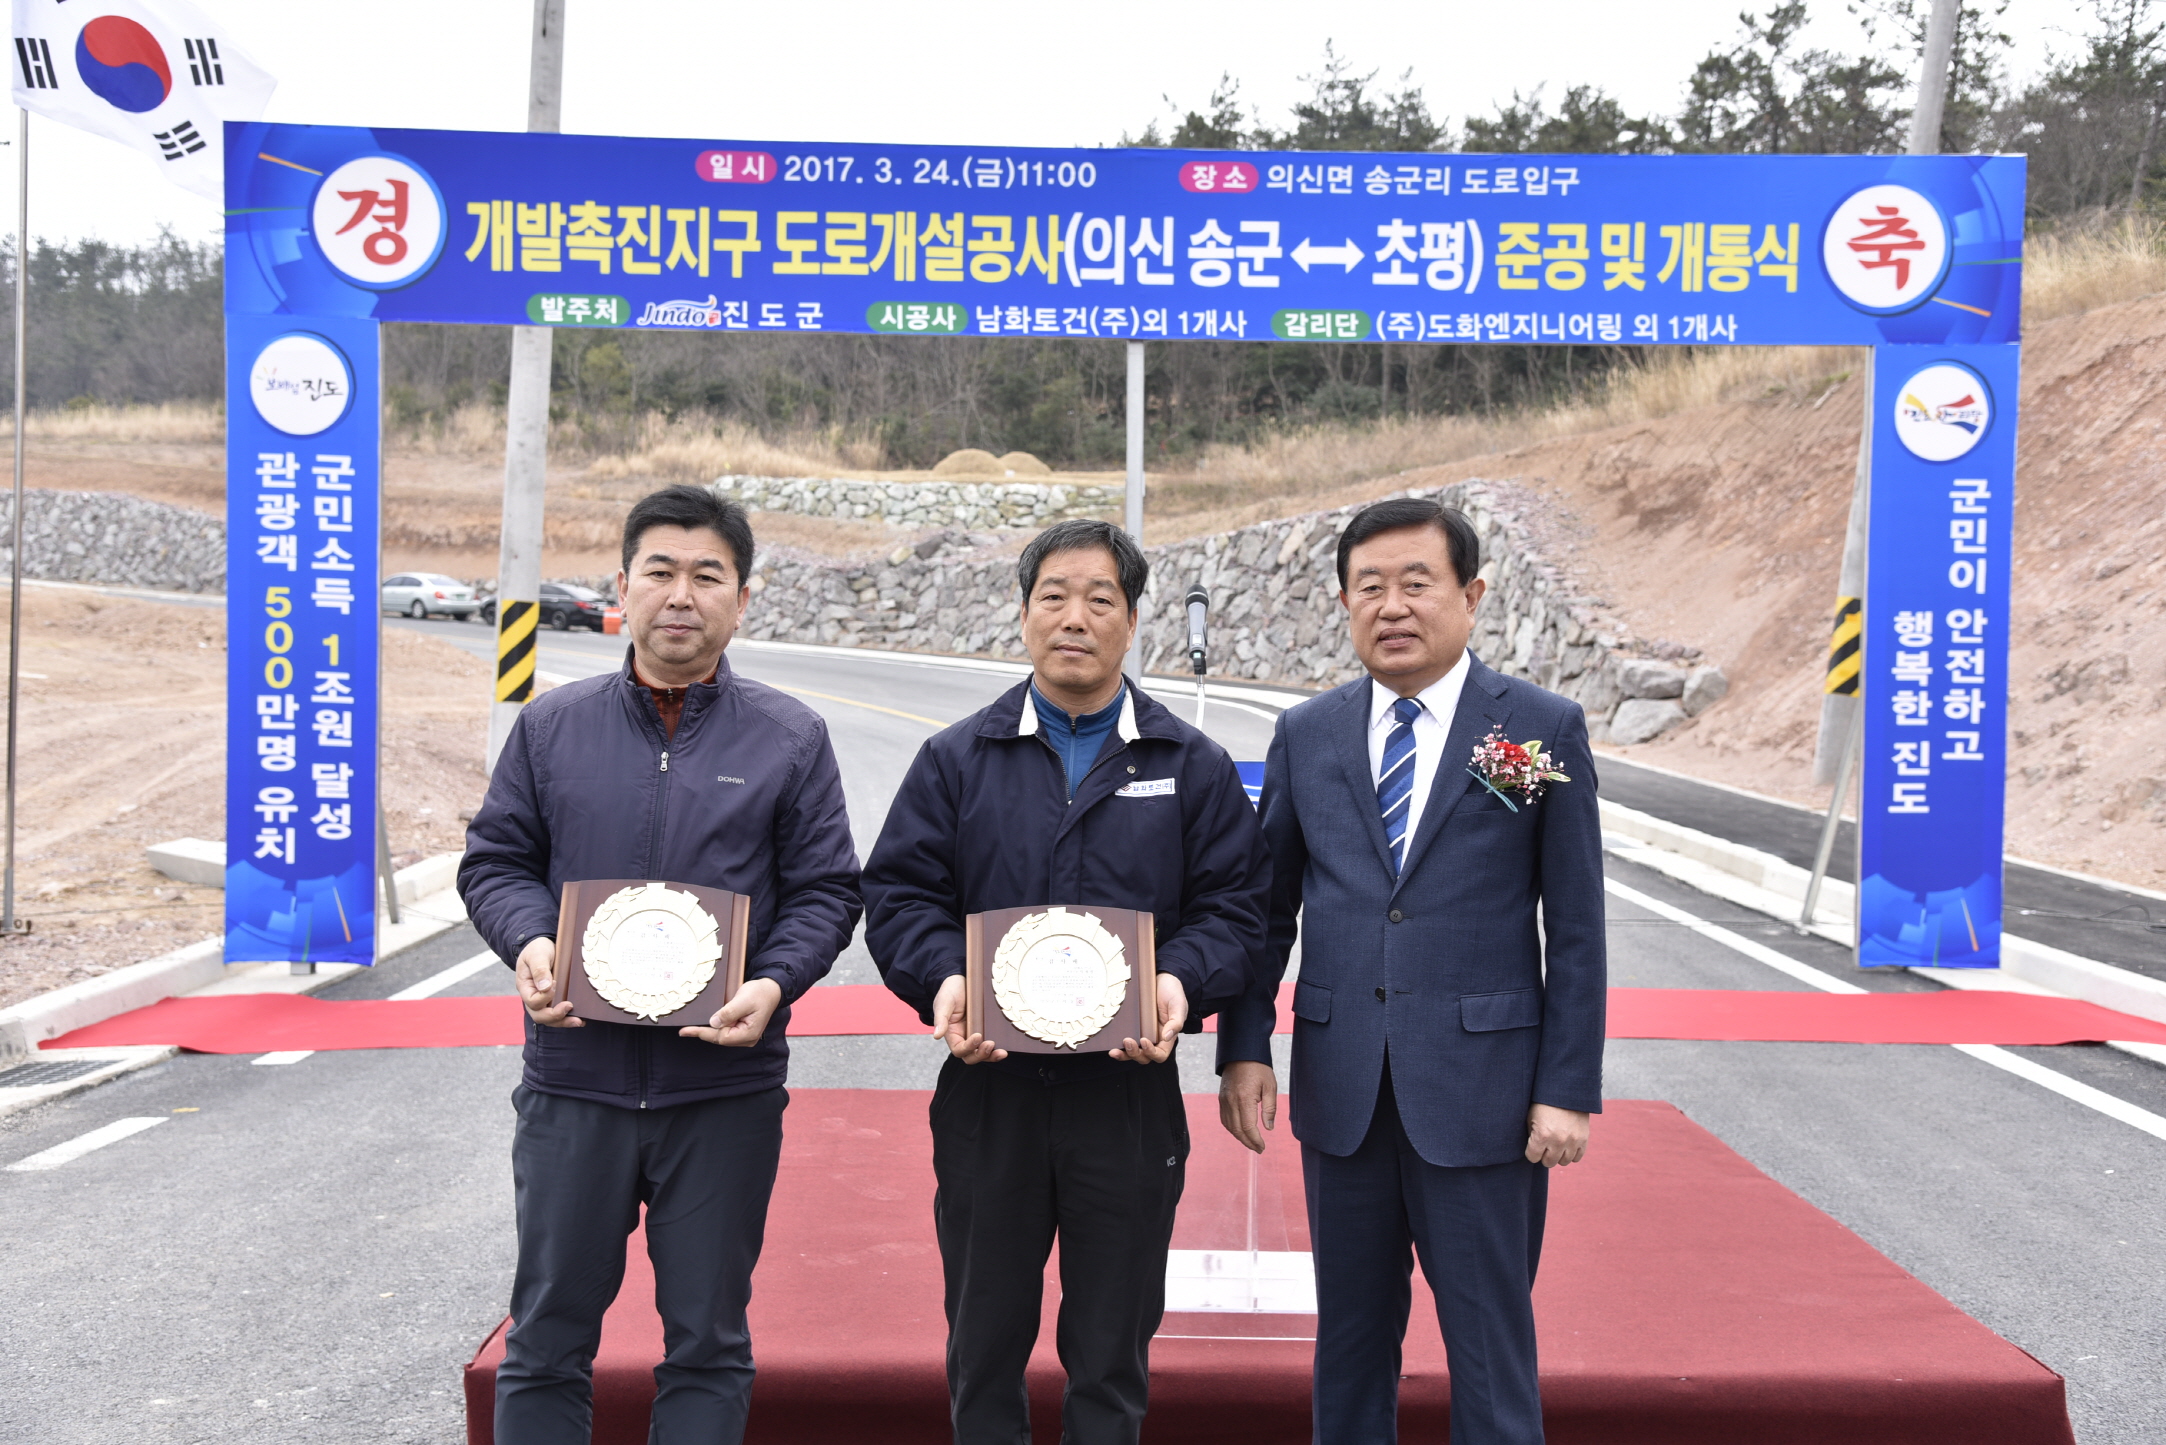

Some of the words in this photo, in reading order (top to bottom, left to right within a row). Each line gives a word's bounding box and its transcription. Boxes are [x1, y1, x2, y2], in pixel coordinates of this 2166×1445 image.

[784, 155, 863, 184] 2017.
[1266, 164, 1353, 194] 의신면
[1363, 165, 1451, 196] 송군리
[1461, 166, 1580, 196] 도로입구
[334, 178, 410, 266] 경
[465, 200, 762, 279] 개발촉진지구
[1495, 222, 1590, 291] 준공
[1600, 221, 1646, 292] 및
[1657, 222, 1800, 293] 개통식
[1847, 205, 1926, 290] 축
[541, 296, 619, 324] 발주처
[880, 304, 957, 331] 시공사
[1178, 309, 1248, 338] 1개사
[1284, 312, 1360, 338] 감리단
[1376, 310, 1622, 342] (주)도화엔지니어링
[1633, 313, 1659, 342] 외
[1668, 313, 1738, 342] 1개사
[302, 378, 345, 402] 진도
[255, 452, 301, 572] 관광객
[311, 454, 356, 615] 군민소득
[1948, 478, 1992, 595] 군민이
[310, 633, 355, 747] 1조원
[1891, 610, 1934, 726] 행복한
[1942, 608, 1988, 761] 안전하고
[311, 762, 354, 840] 달성
[717, 775, 746, 785] DOHWA
[1887, 740, 1931, 814] 진도
[254, 786, 299, 865] 유치
